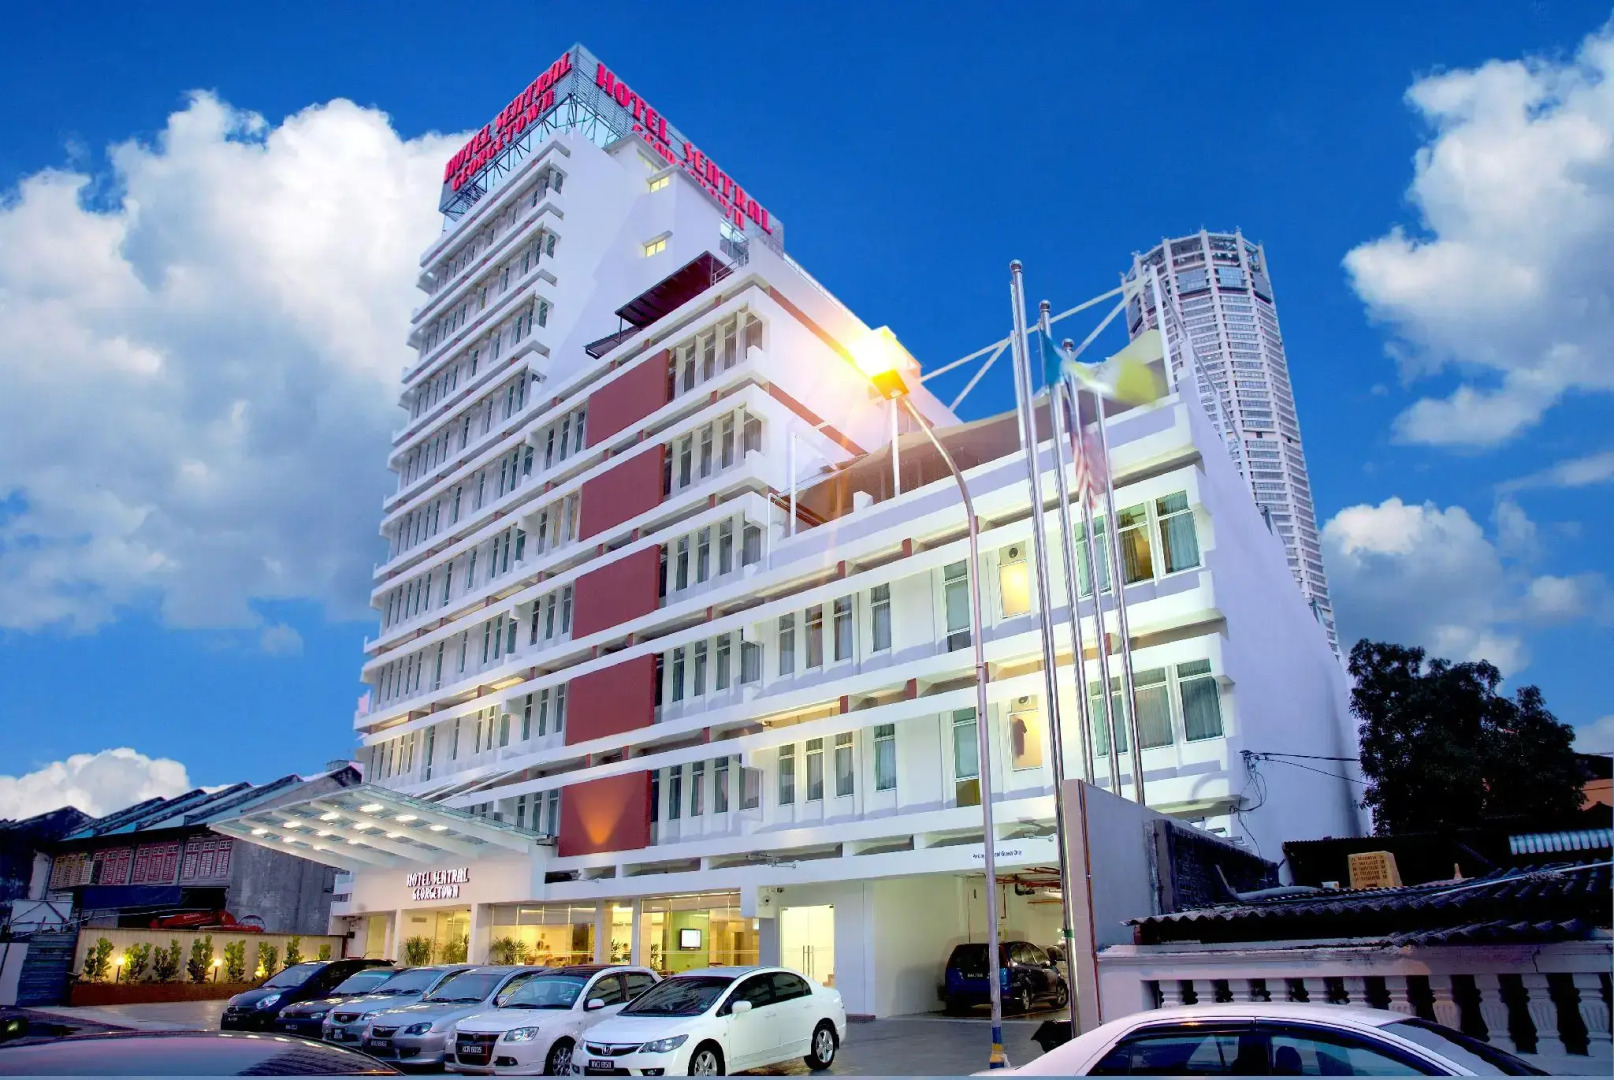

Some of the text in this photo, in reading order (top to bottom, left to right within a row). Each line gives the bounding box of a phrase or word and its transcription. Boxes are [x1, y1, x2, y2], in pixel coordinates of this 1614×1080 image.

[444, 52, 572, 183] HOTEL SENTRAL
[451, 89, 555, 192] GEORGETOWN
[595, 62, 773, 236] HOTEL SENTRAL
[406, 867, 470, 887] HOTEL SENTRAL
[413, 885, 460, 901] GEORGETOWN
